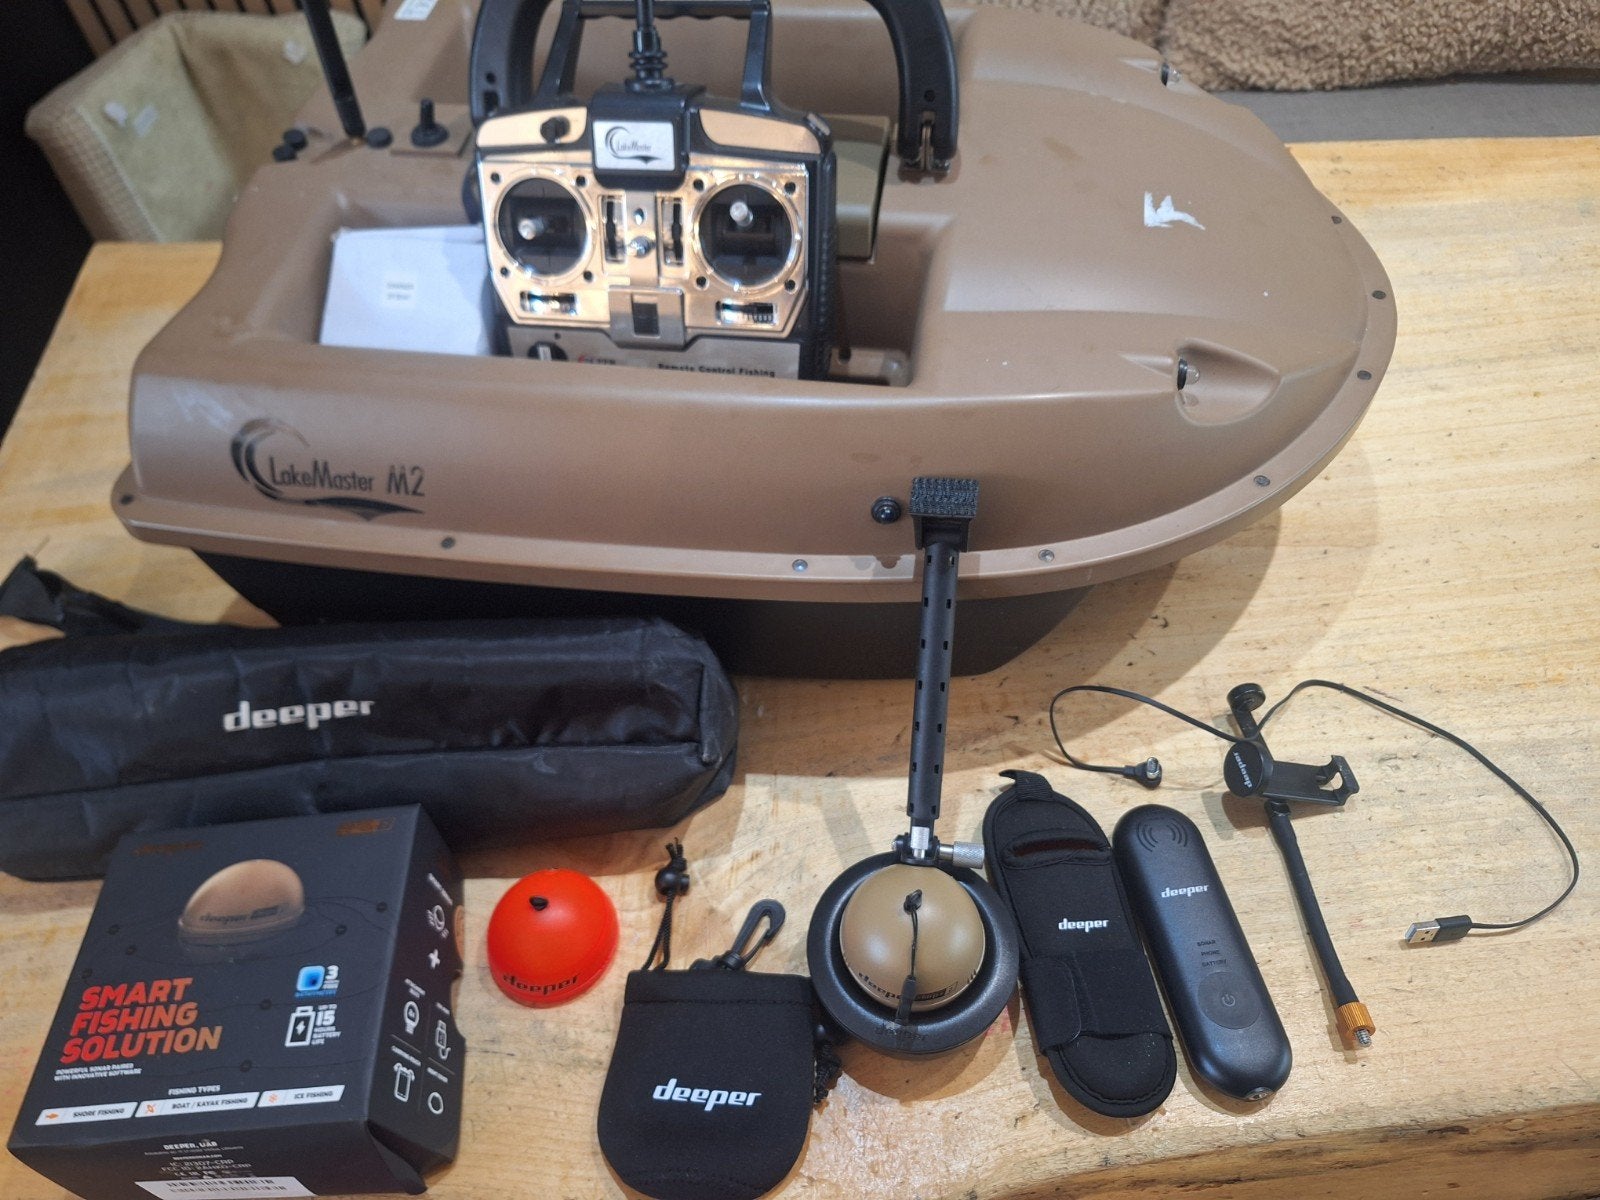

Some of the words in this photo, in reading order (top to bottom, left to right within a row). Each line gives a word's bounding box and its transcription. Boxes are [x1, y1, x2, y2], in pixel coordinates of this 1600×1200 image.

[698, 366, 736, 375] Control
[739, 368, 775, 378] Fishing
[269, 456, 374, 492] LakeMaster
[387, 464, 425, 497] M2
[223, 700, 375, 732] deeper
[1233, 752, 1253, 788] deeper
[1161, 884, 1209, 898] deeper
[1058, 918, 1109, 932] deeper
[325, 965, 339, 980] 3
[503, 973, 580, 995] deeper
[79, 977, 194, 1011] SMART
[70, 1001, 199, 1036] FISHING
[316, 1010, 336, 1026] 15
[59, 1026, 224, 1064] SOLUTION
[168, 1086, 197, 1096] FISHING
[198, 1084, 221, 1093] TYPES
[306, 1090, 334, 1099] FISHING
[652, 1078, 762, 1111] deeper
[172, 1101, 191, 1109] BOAT
[196, 1100, 219, 1108] KAYAK
[220, 1097, 248, 1106] FISHING
[72, 1109, 96, 1118] SHORE
[97, 1107, 125, 1116] FISHING
